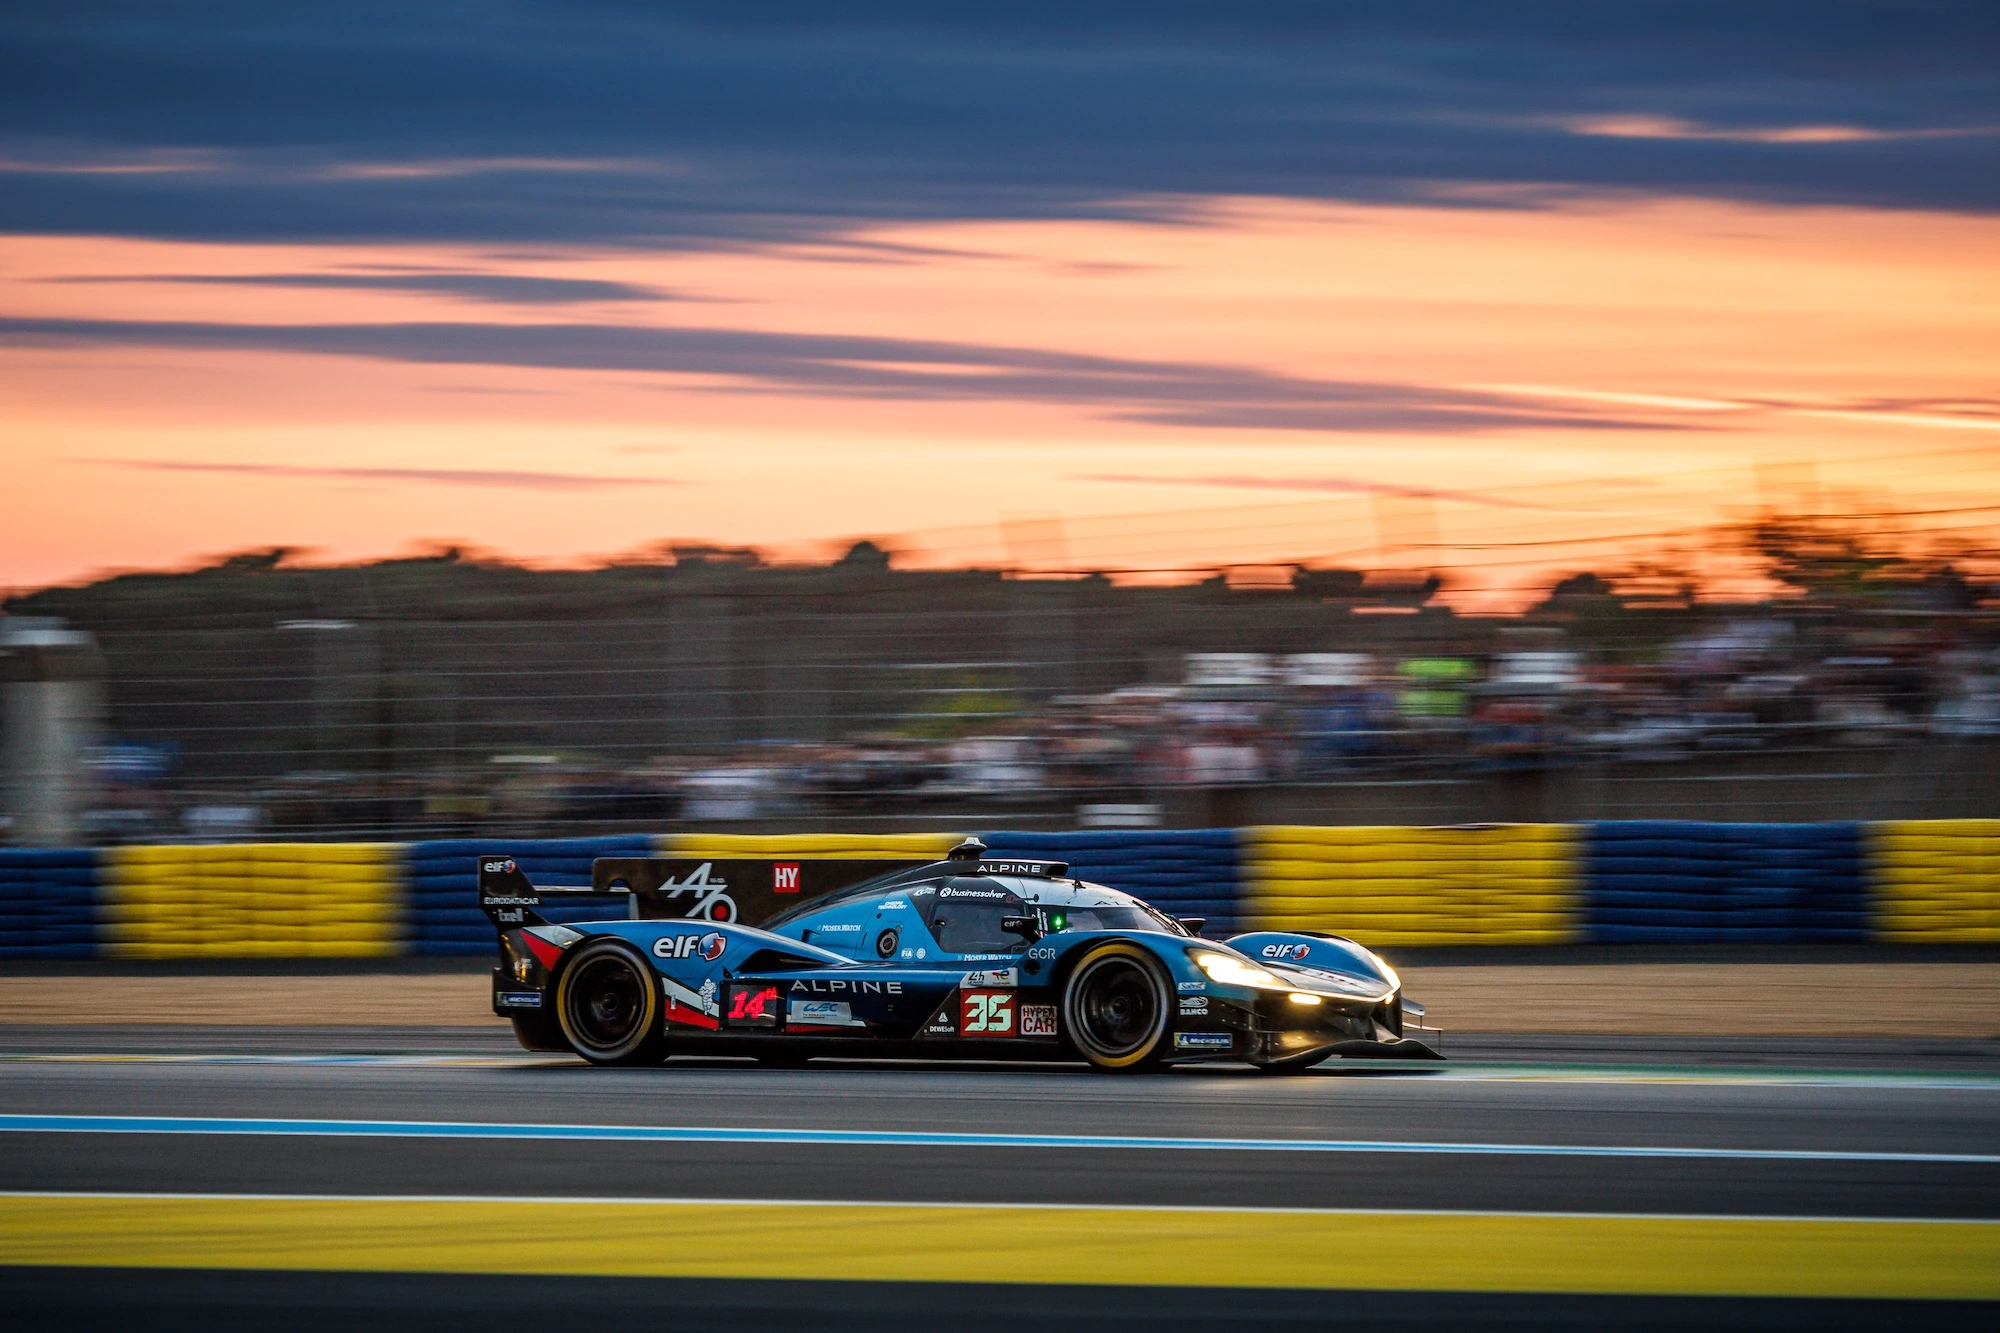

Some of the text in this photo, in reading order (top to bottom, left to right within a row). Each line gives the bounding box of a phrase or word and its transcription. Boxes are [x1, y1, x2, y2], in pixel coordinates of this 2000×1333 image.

[484, 861, 504, 872] elf
[977, 864, 1041, 873] ALPINE
[775, 867, 799, 888] HY
[950, 888, 1006, 900] businessolver
[821, 924, 861, 932] MOSER WATCH
[653, 935, 700, 958] elf
[1262, 944, 1293, 958] elf
[901, 949, 913, 958] FIA
[1028, 948, 1056, 960] GCR
[790, 979, 903, 994] ALPINE
[803, 1002, 838, 1013] WEC
[964, 994, 1013, 1032] 35
[1023, 1007, 1056, 1018] HYPER
[1022, 1017, 1056, 1033] CAR
